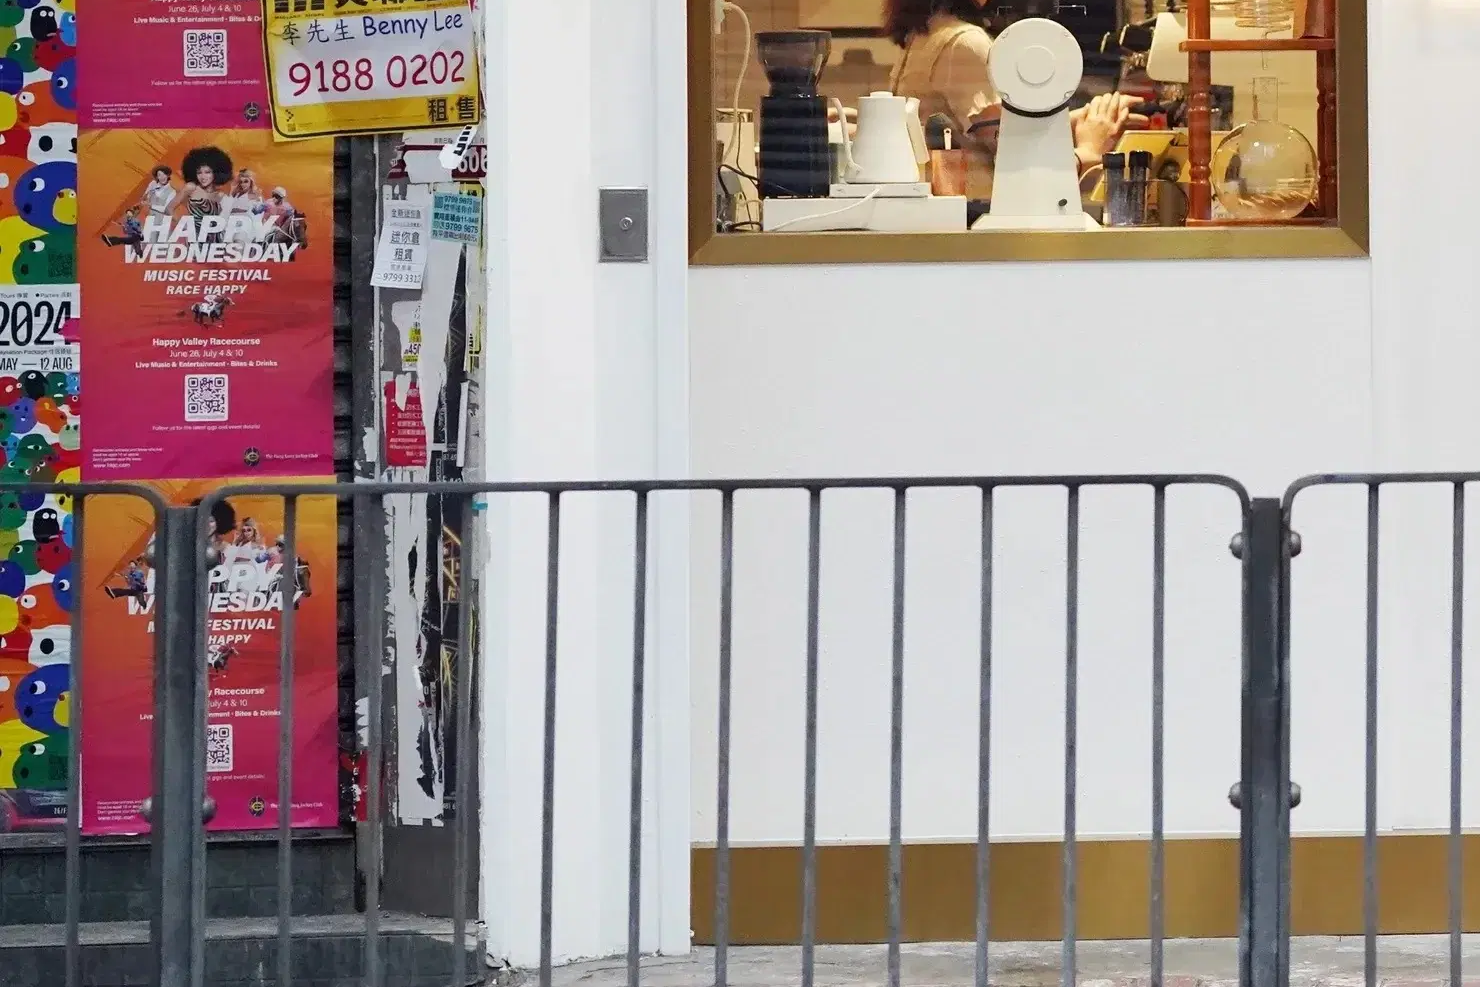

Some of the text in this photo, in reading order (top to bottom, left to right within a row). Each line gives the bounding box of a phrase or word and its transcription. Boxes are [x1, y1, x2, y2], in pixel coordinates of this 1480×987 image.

[233, 4, 241, 12] 10
[282, 10, 463, 45] 李先生 Benny Lee
[288, 50, 464, 96] 9188 0202
[142, 214, 280, 243] HAPPY
[124, 242, 300, 264] WEDNESDAY
[143, 269, 272, 282] MUSIC FESTIVAL
[383, 272, 403, 282] 9799
[166, 285, 247, 295] RACE HAPPY
[152, 337, 260, 348] Happy Valley Racecourse
[169, 350, 187, 358] June
[202, 349, 217, 359] July
[40, 357, 50, 370] 12
[52, 357, 73, 370] AUG
[208, 634, 252, 645] HAPPY
[214, 688, 265, 696] Racecourse
[239, 699, 248, 707] 10
[260, 708, 281, 716] Drinks
